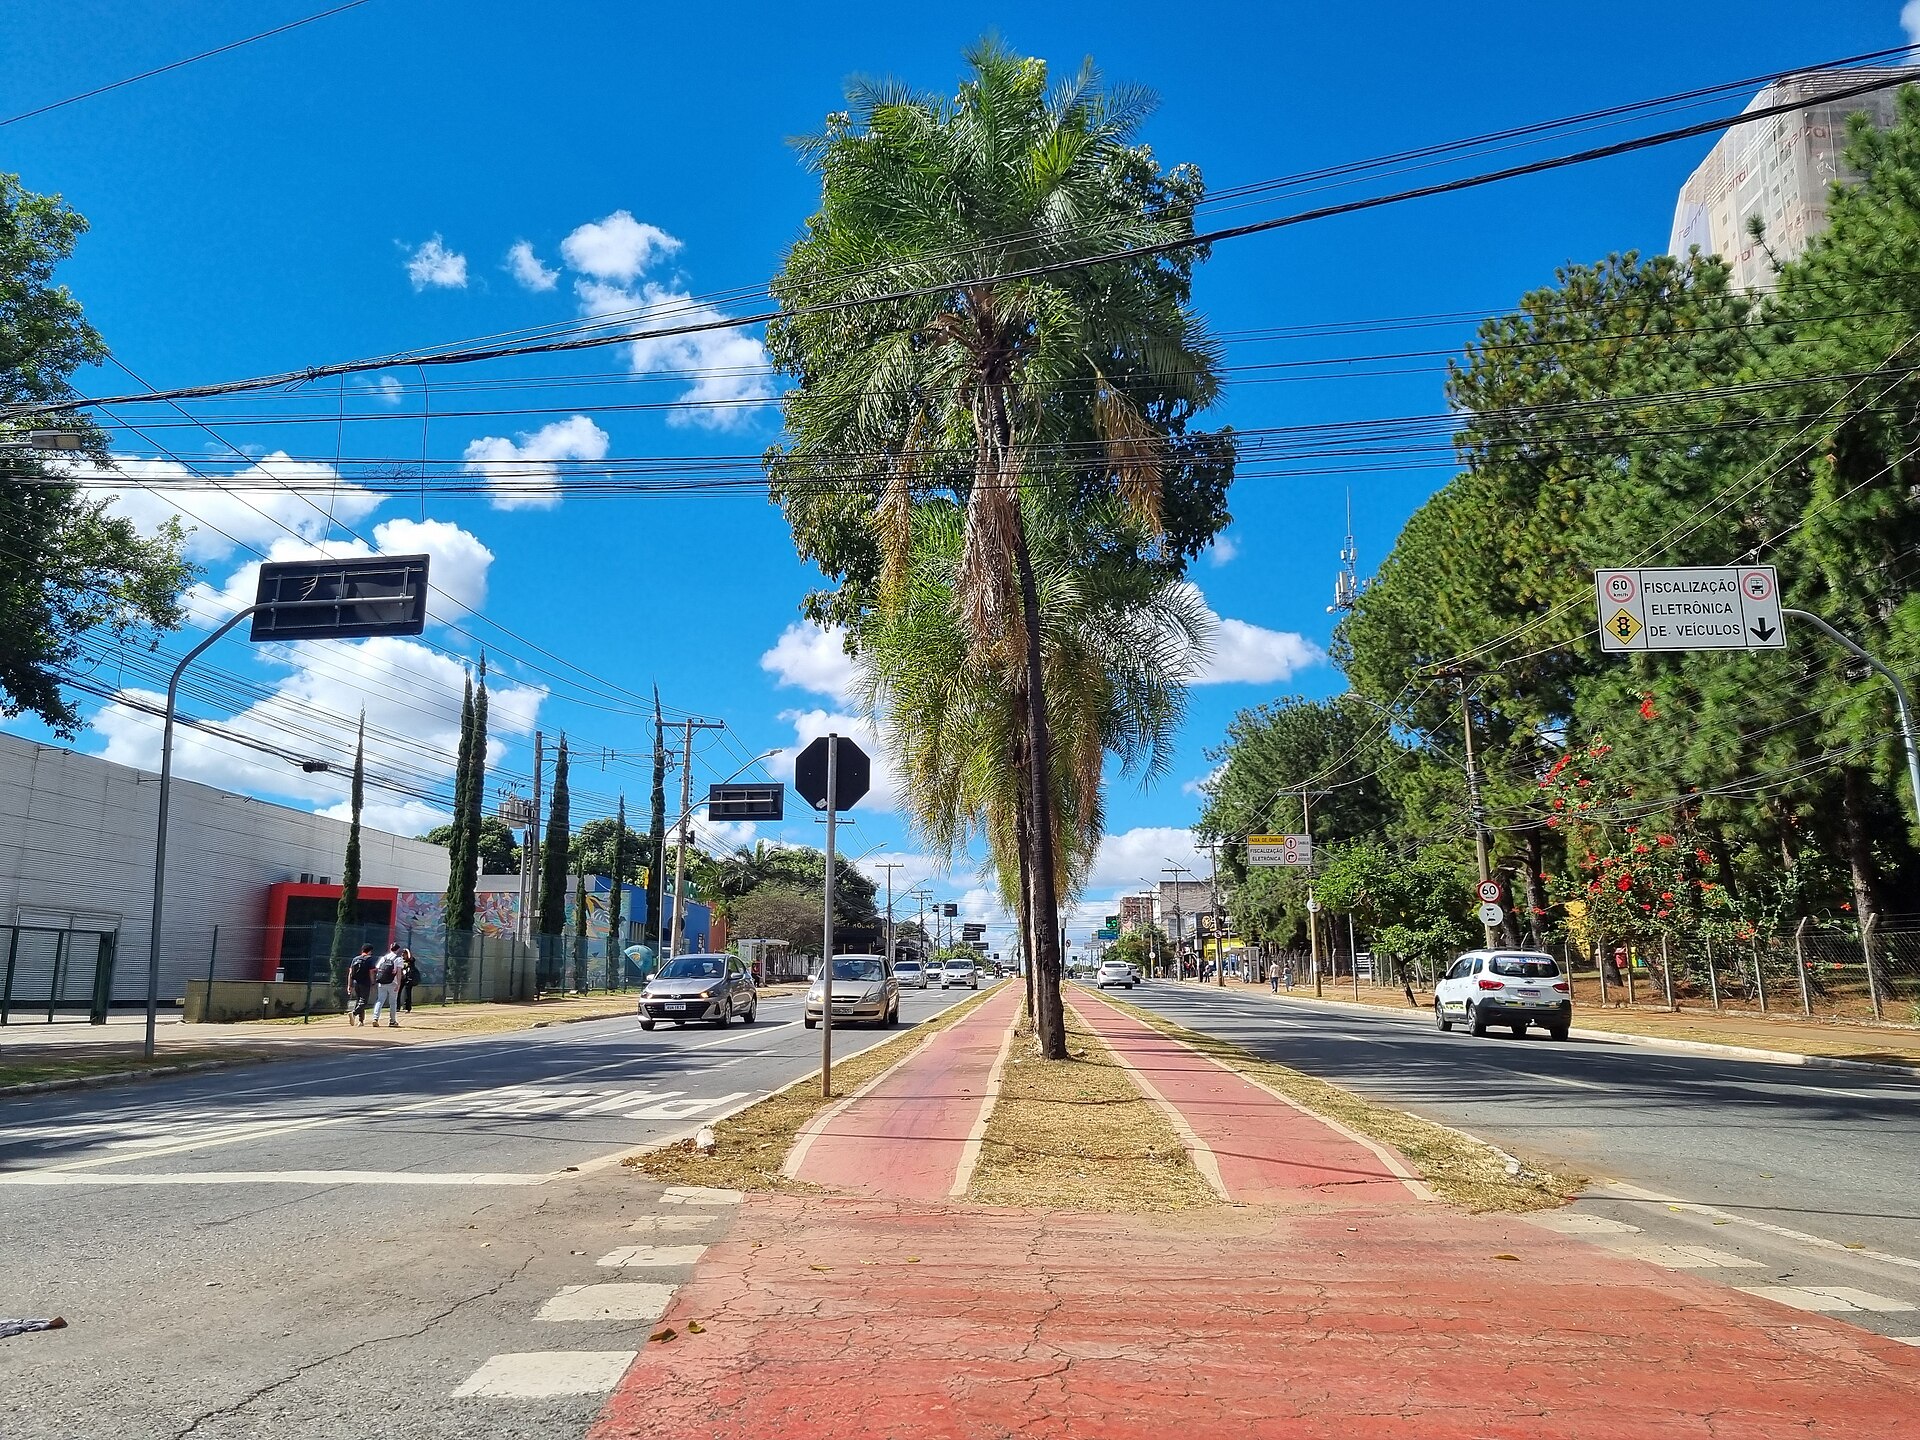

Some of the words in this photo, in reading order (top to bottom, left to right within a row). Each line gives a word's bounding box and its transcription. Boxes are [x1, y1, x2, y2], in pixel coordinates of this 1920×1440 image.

[1612, 580, 1628, 591] 60
[1644, 579, 1737, 595] FISCALIZAÇÃO
[1651, 600, 1733, 616] ELETRÔNICA
[1650, 626, 1667, 637] DE
[1676, 621, 1741, 637] VEÍCULOS
[1481, 885, 1497, 896] 60
